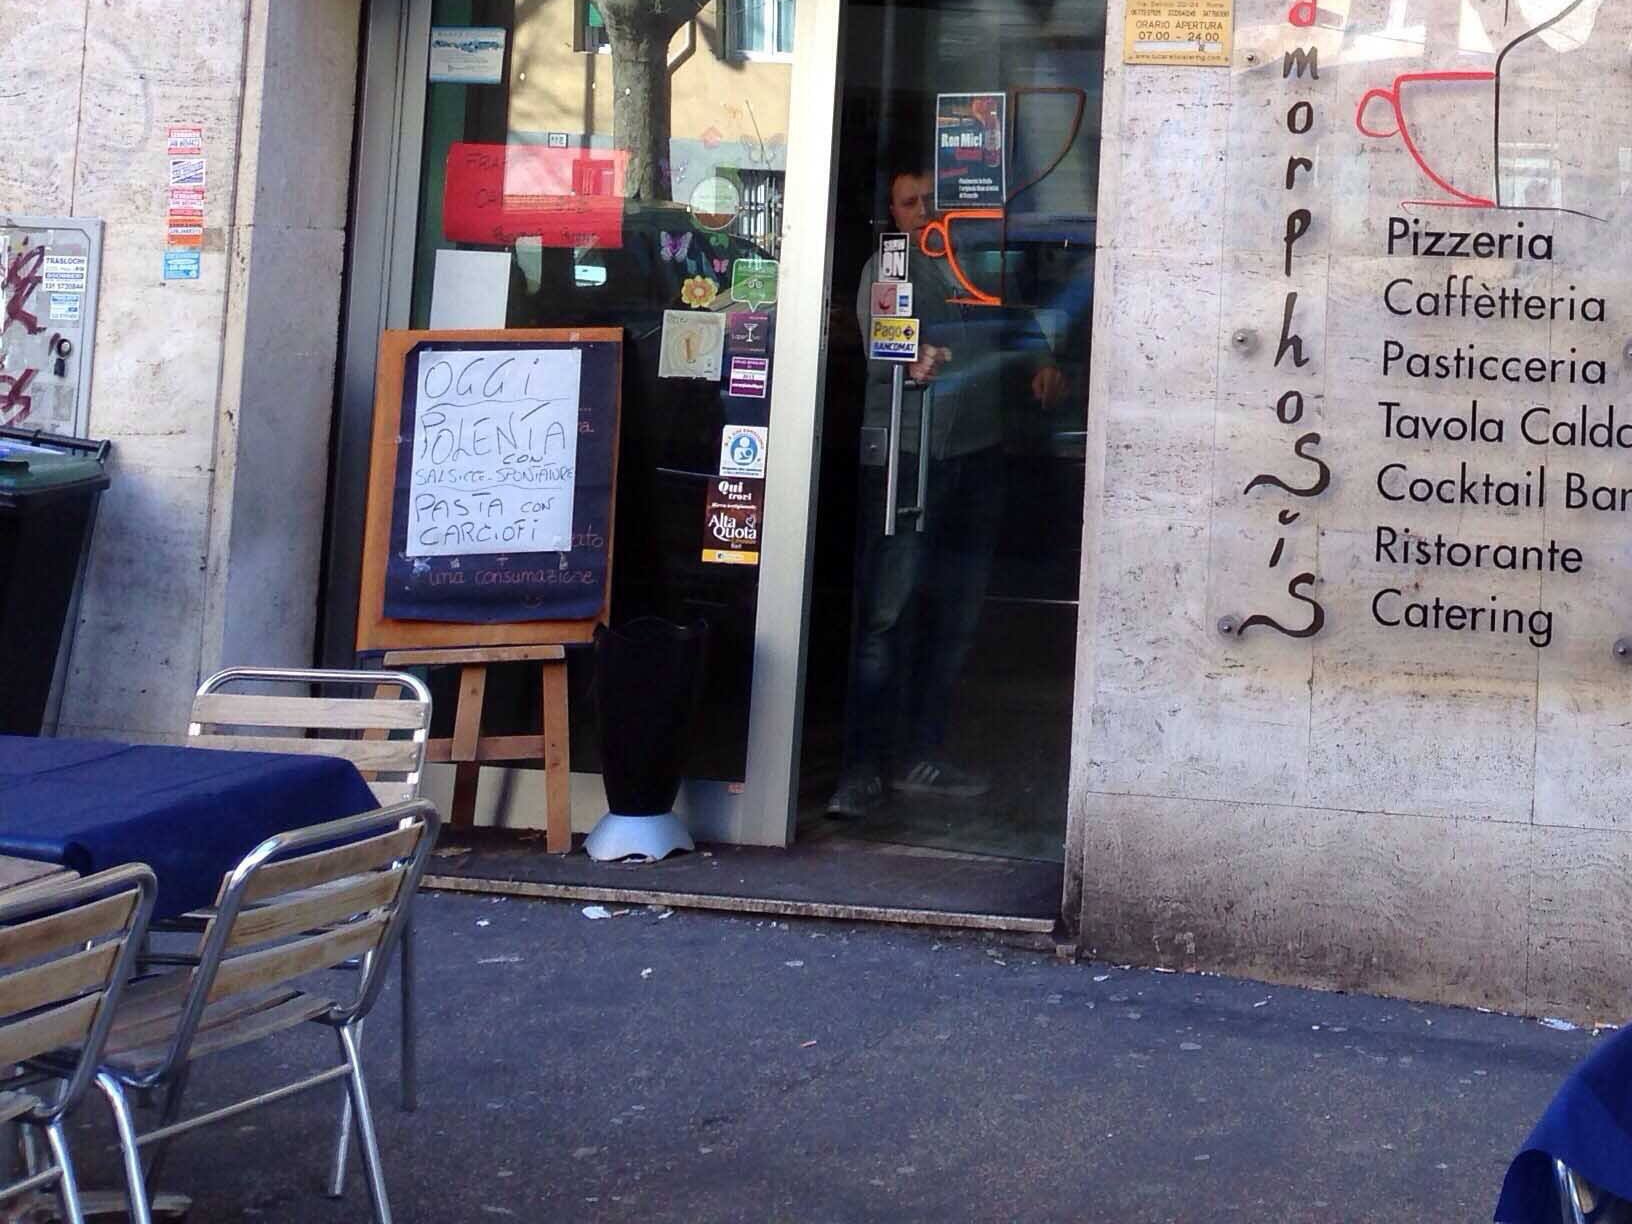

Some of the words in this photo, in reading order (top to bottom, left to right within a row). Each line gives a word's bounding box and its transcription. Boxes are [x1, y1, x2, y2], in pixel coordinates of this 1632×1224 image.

[1136, 20, 1170, 30] ORARIO
[1176, 21, 1223, 31] APERTURA
[1387, 217, 1555, 261] Pizzeria
[874, 321, 902, 341] Pago
[873, 341, 915, 353] BANCOMAT
[1382, 340, 1608, 385] Pasticceria
[420, 402, 566, 465] POLENTA
[1378, 400, 1504, 444] Tavola
[718, 480, 744, 495] Qui
[1376, 462, 1546, 508] Cocktail
[415, 492, 504, 523] PASTA
[520, 497, 555, 513] CON
[708, 512, 737, 529] Alta
[419, 519, 539, 546] CARCIOFI
[713, 525, 757, 542] Quota
[1375, 526, 1584, 574] Ristorante
[1372, 588, 1555, 648] Catering
